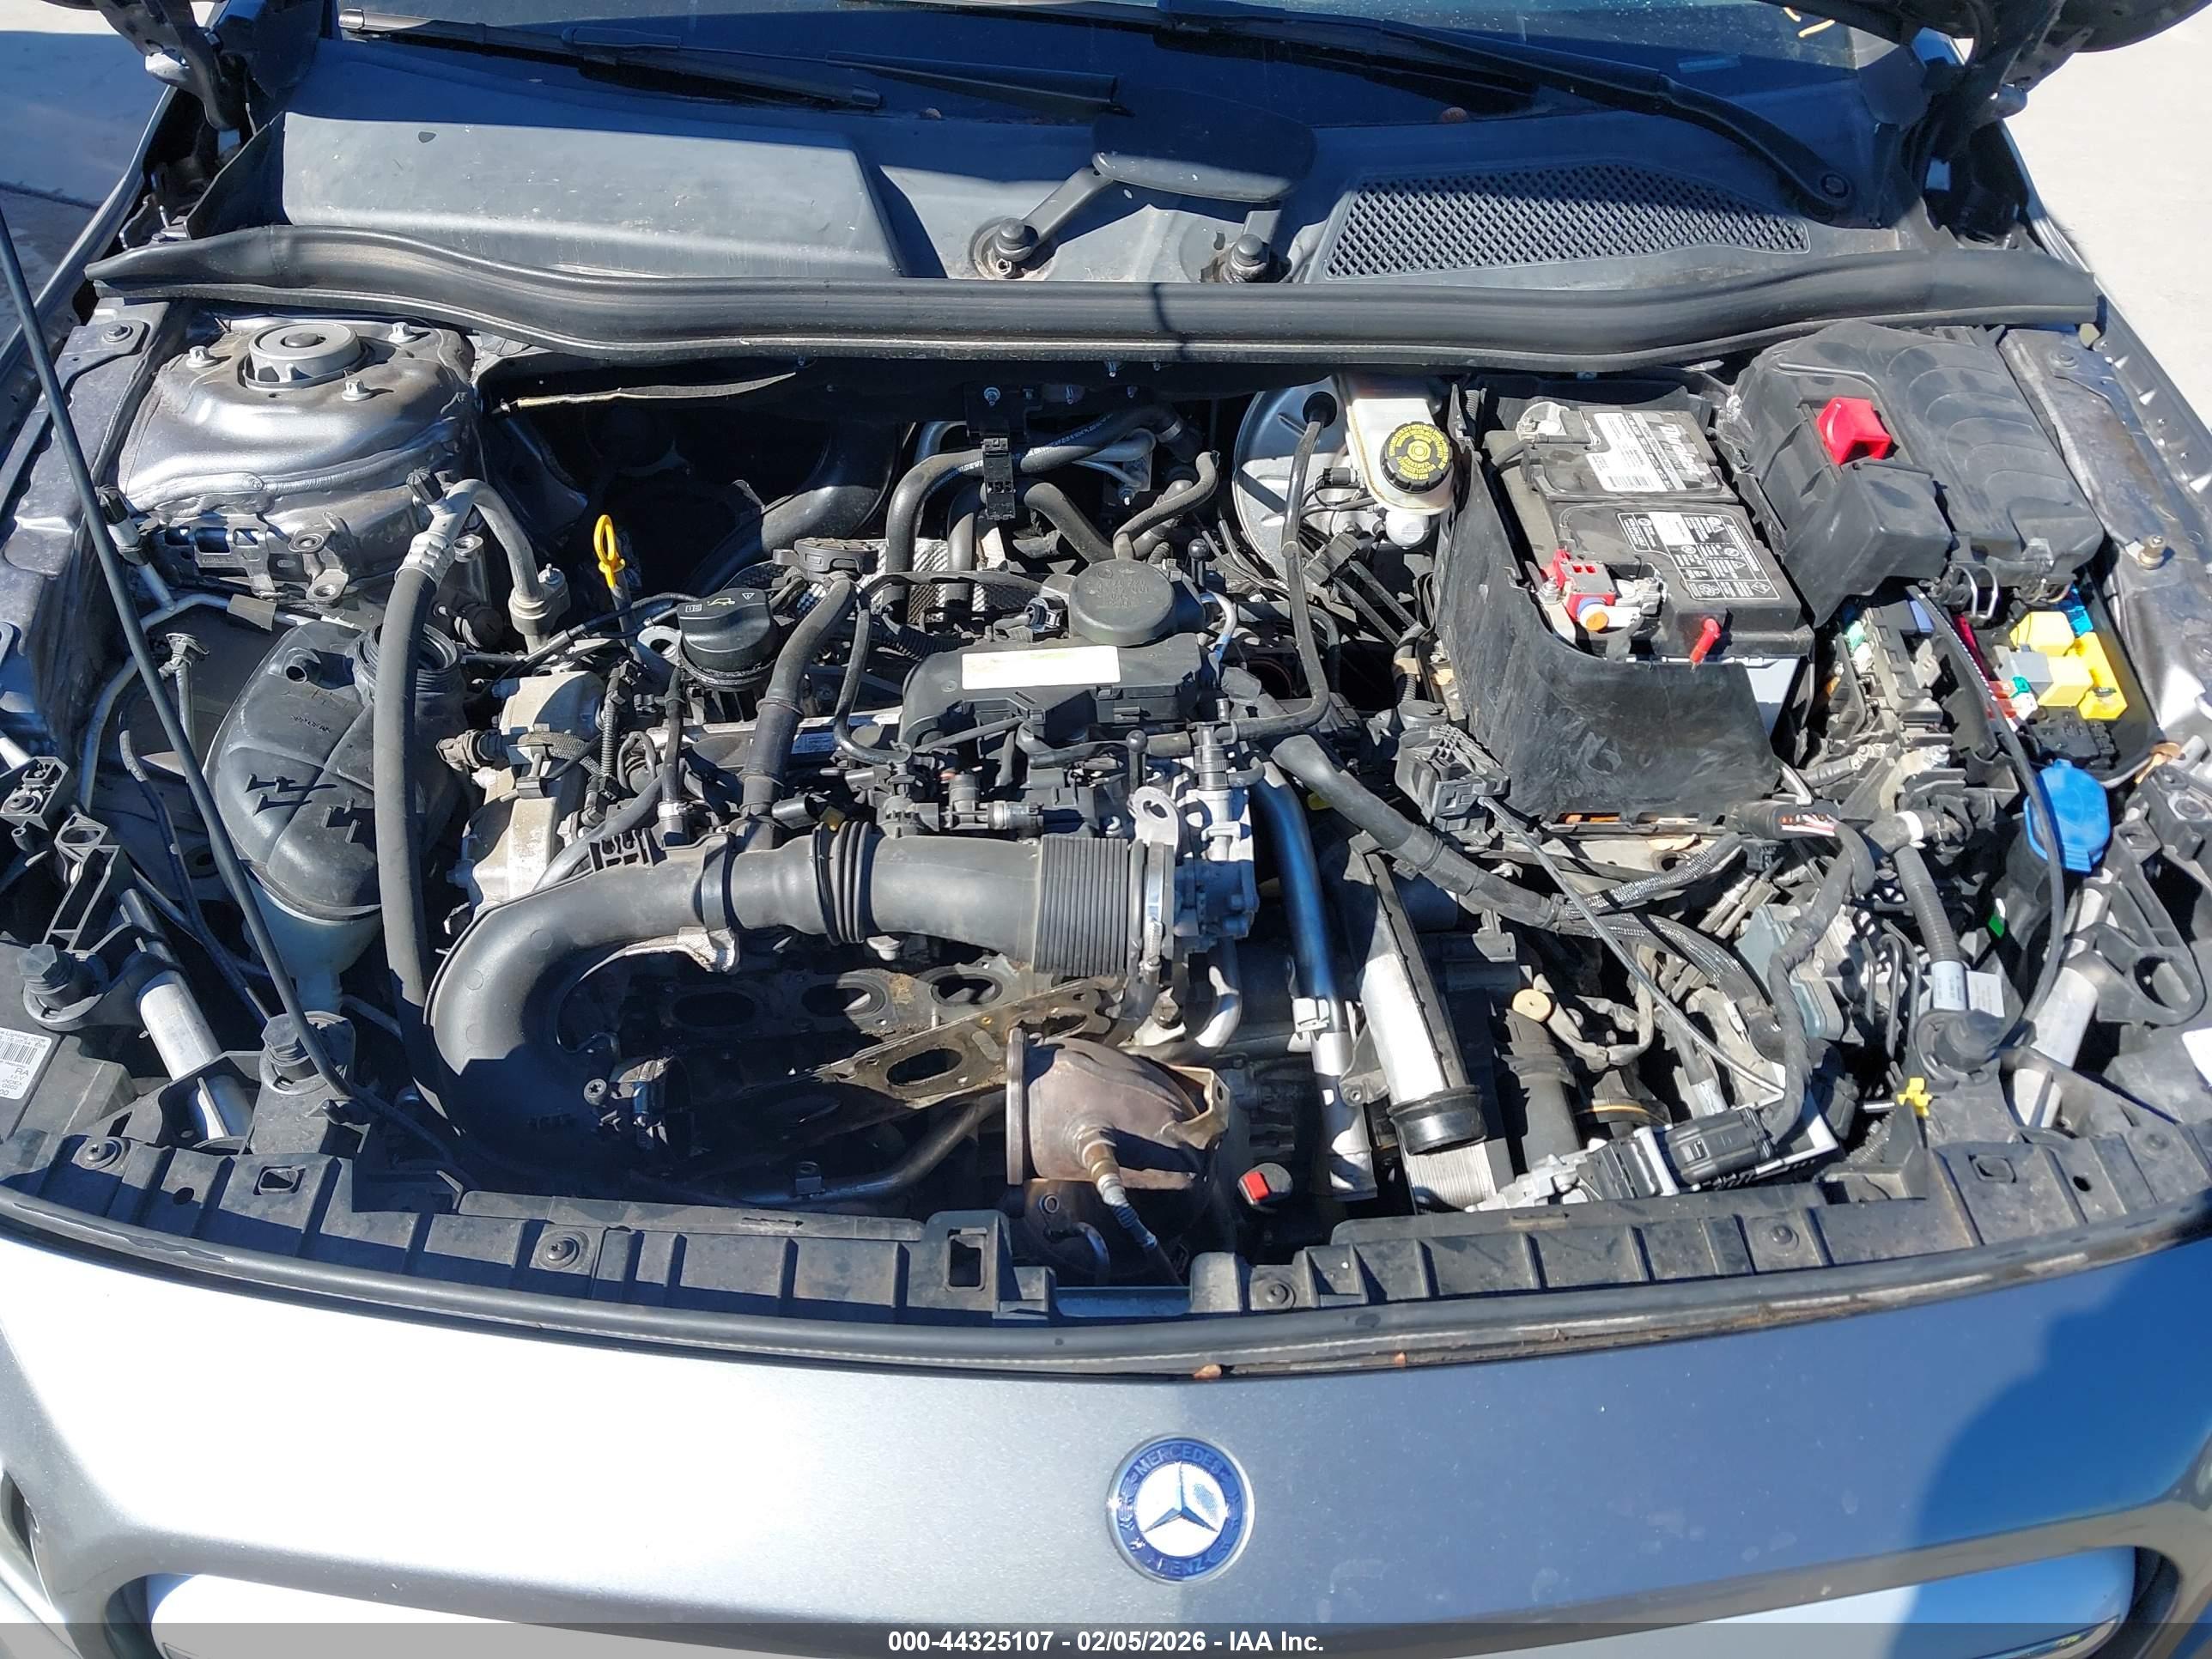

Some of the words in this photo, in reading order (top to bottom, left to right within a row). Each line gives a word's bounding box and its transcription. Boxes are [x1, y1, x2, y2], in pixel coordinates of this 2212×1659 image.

[1658, 422, 1707, 477] Duralast
[15, 1067, 28, 1076] RA
[1133, 1443, 1224, 1476] MERCEDES
